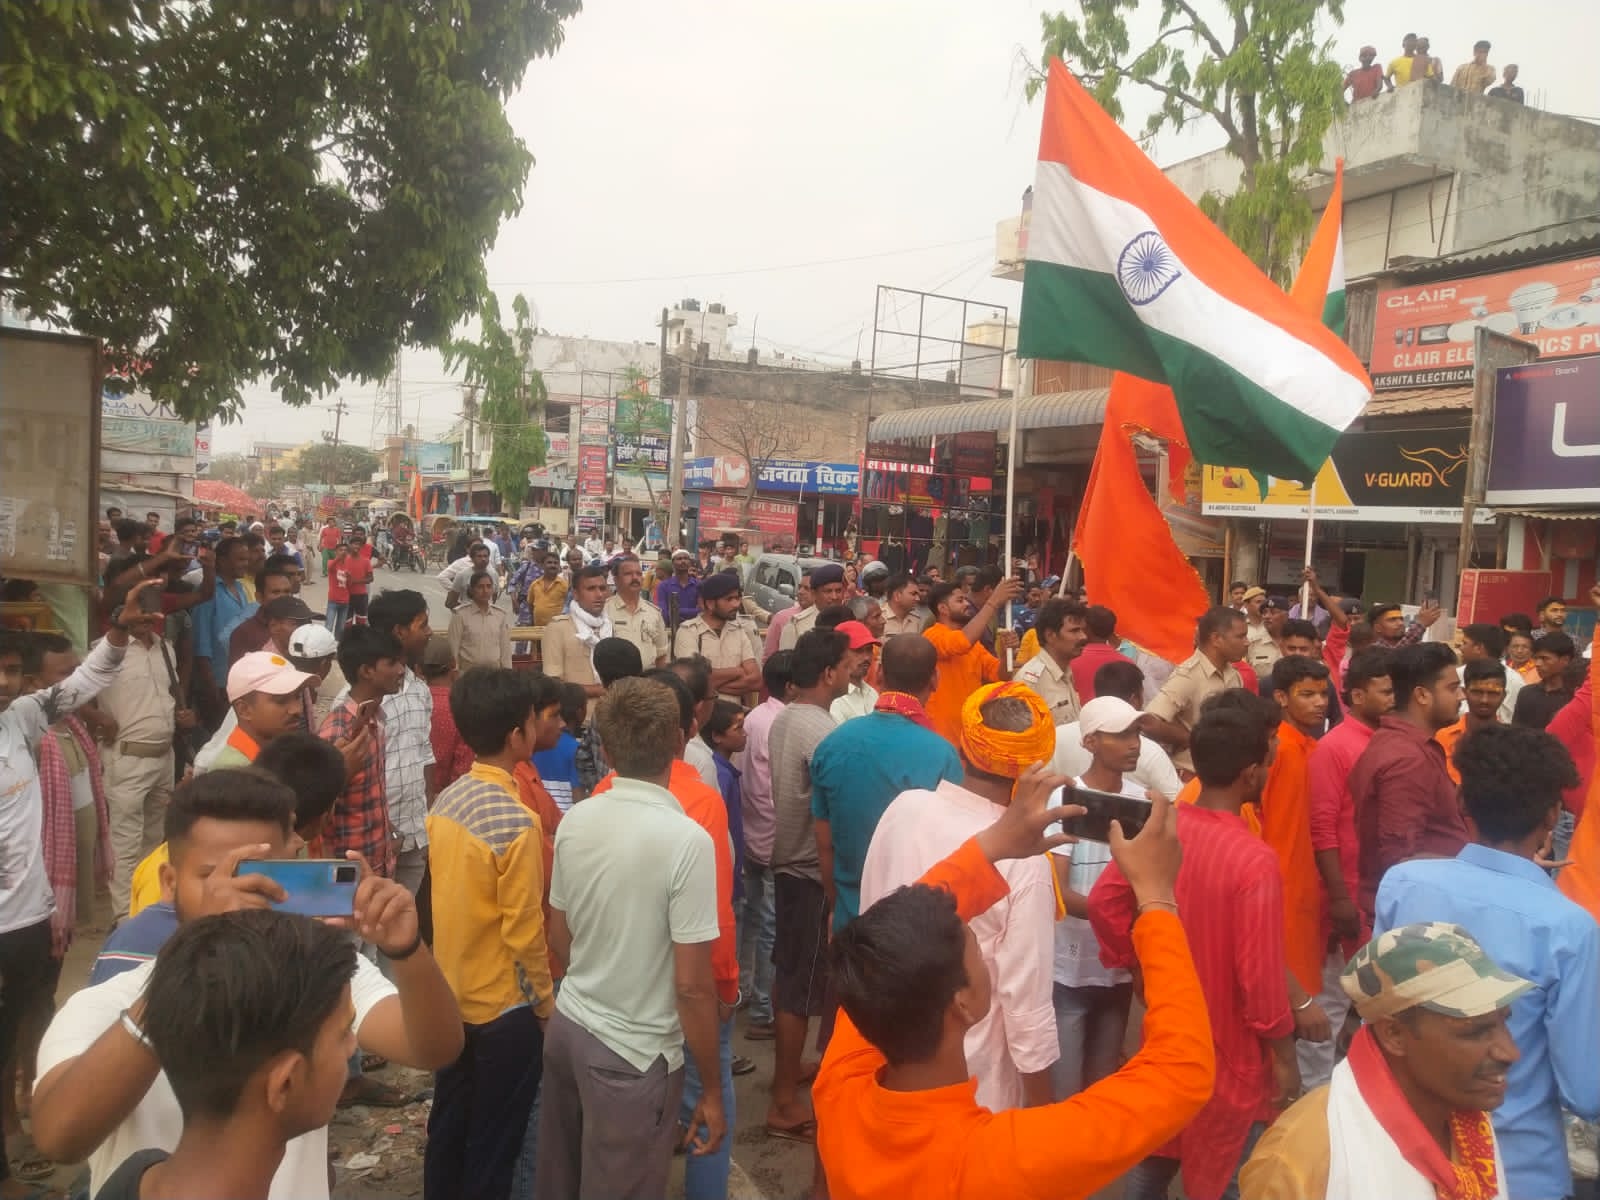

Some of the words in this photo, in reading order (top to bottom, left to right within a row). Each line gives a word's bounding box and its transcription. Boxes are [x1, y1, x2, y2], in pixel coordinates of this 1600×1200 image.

[1386, 287, 1457, 308] CLAIR
[1393, 350, 1441, 368] CLAIR
[758, 466, 809, 484] जनता
